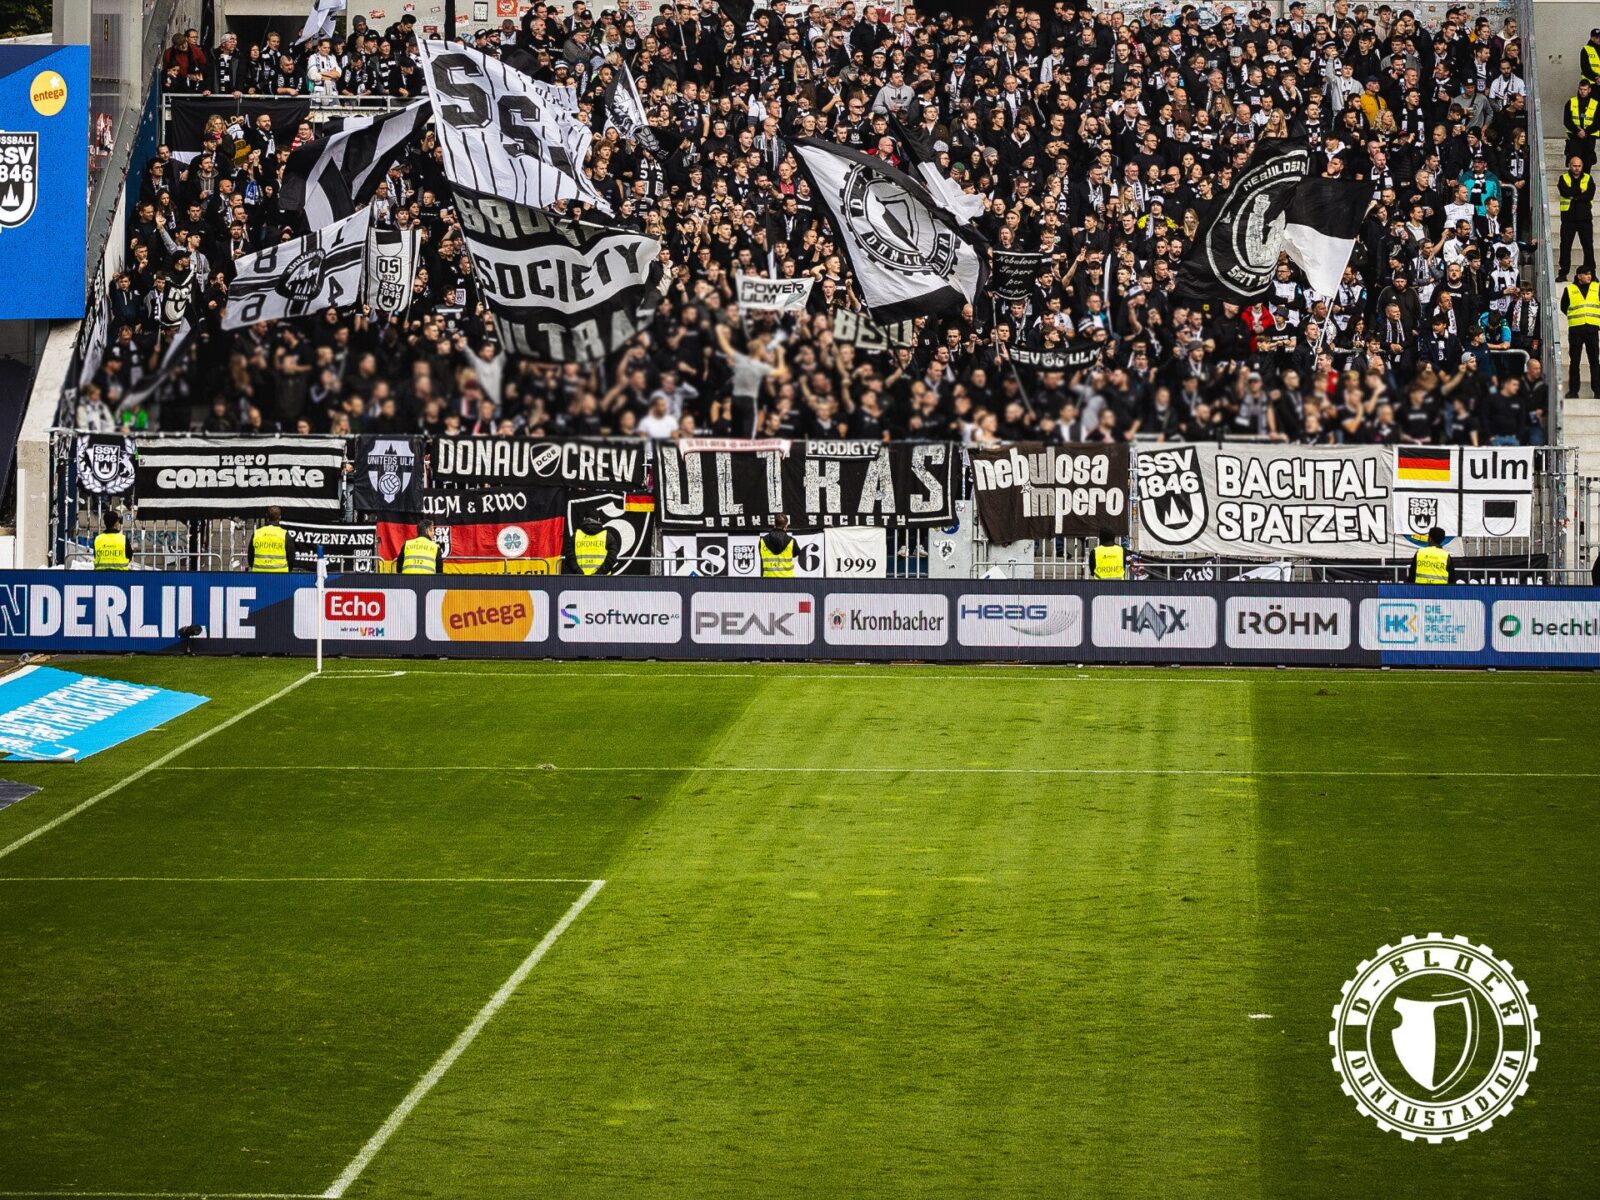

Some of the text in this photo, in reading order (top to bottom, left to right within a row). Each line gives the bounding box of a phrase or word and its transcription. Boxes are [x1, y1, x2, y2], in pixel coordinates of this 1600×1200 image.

[34, 88, 64, 102] entega
[0, 136, 34, 144] SSBALL
[0, 165, 33, 182] 846
[473, 242, 642, 302] SOCIETY
[1227, 265, 1256, 286] SEIT
[381, 282, 403, 292] SSV
[742, 282, 804, 294] POWER
[380, 289, 401, 299] 1846
[741, 293, 777, 304] ULM
[95, 446, 117, 455] SSV
[808, 440, 880, 456] PRODIGYS
[94, 454, 117, 462] 1846
[221, 454, 266, 466] nero
[368, 456, 414, 467] UNITEDS ULM
[438, 438, 637, 482] DONAU CREW
[1137, 449, 1194, 477] SSV
[383, 464, 398, 472] 1997
[974, 446, 1109, 491] nebulosa
[1470, 452, 1528, 480] ulm
[157, 465, 324, 489] constante
[1215, 455, 1388, 501] BACHTAL
[1138, 471, 1200, 499] 1846
[467, 500, 476, 513] &
[1410, 498, 1436, 508] SSV
[1023, 487, 1124, 534] impero
[1410, 507, 1436, 517] 1846
[705, 515, 906, 528] BROKE SOCIETY
[1216, 502, 1388, 544] SPATZEN
[288, 529, 374, 545] PATZENFANS
[433, 527, 449, 536] SV
[255, 541, 282, 550] ORDNER
[433, 535, 449, 544] 846
[576, 540, 605, 548] ORDNER
[734, 552, 754, 560] 1846
[835, 557, 877, 574] 1999
[1417, 559, 1446, 570] ORDNER
[330, 596, 381, 617] Echo
[1425, 605, 1441, 614] DIE
[450, 602, 527, 630] entega
[585, 608, 670, 626] software
[850, 609, 944, 631] Krombacher
[1237, 604, 1338, 636] RÖHM
[695, 611, 795, 636] PEAK
[360, 627, 385, 637] VRM
